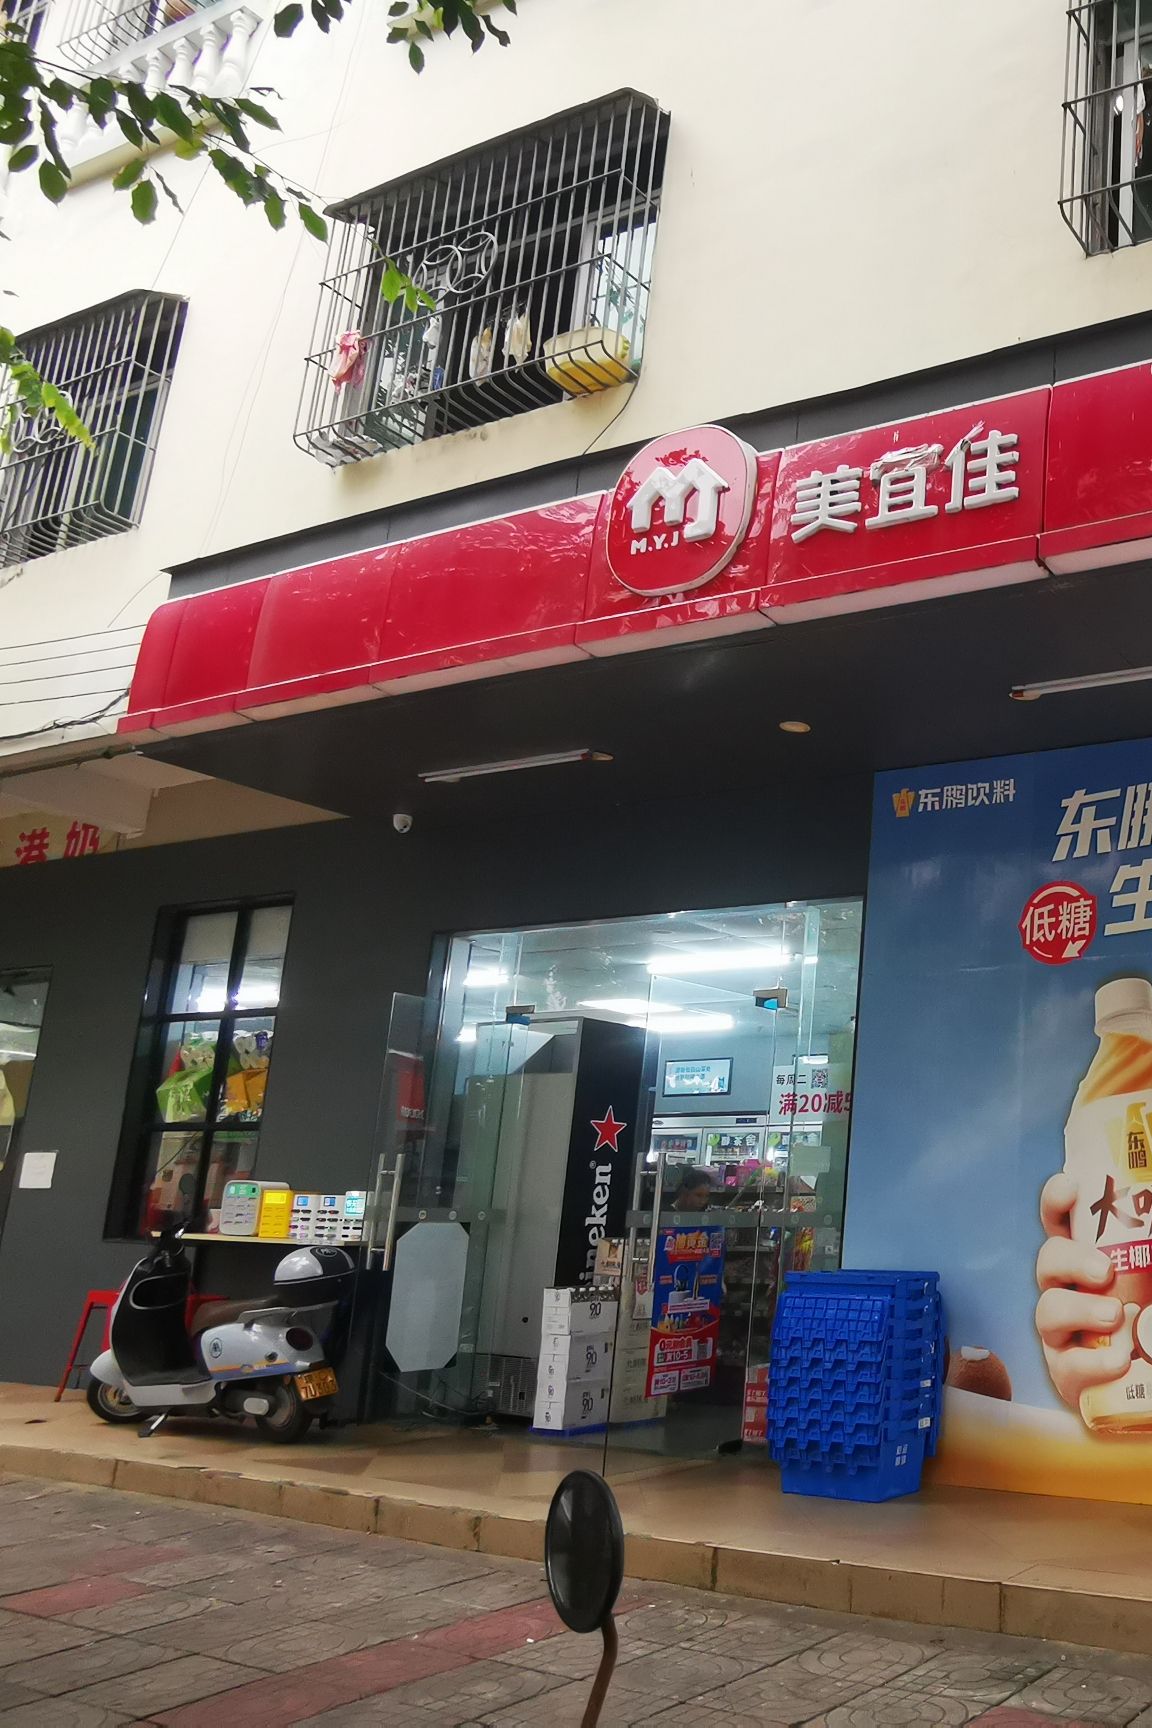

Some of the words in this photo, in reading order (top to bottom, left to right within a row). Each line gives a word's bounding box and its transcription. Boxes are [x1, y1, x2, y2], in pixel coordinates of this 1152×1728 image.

[790, 429, 1019, 543] 美宜佳
[630, 531, 680, 555] M.Y.J
[918, 778, 1016, 813] 东鹏饮料
[1019, 895, 1094, 943] 低糖
